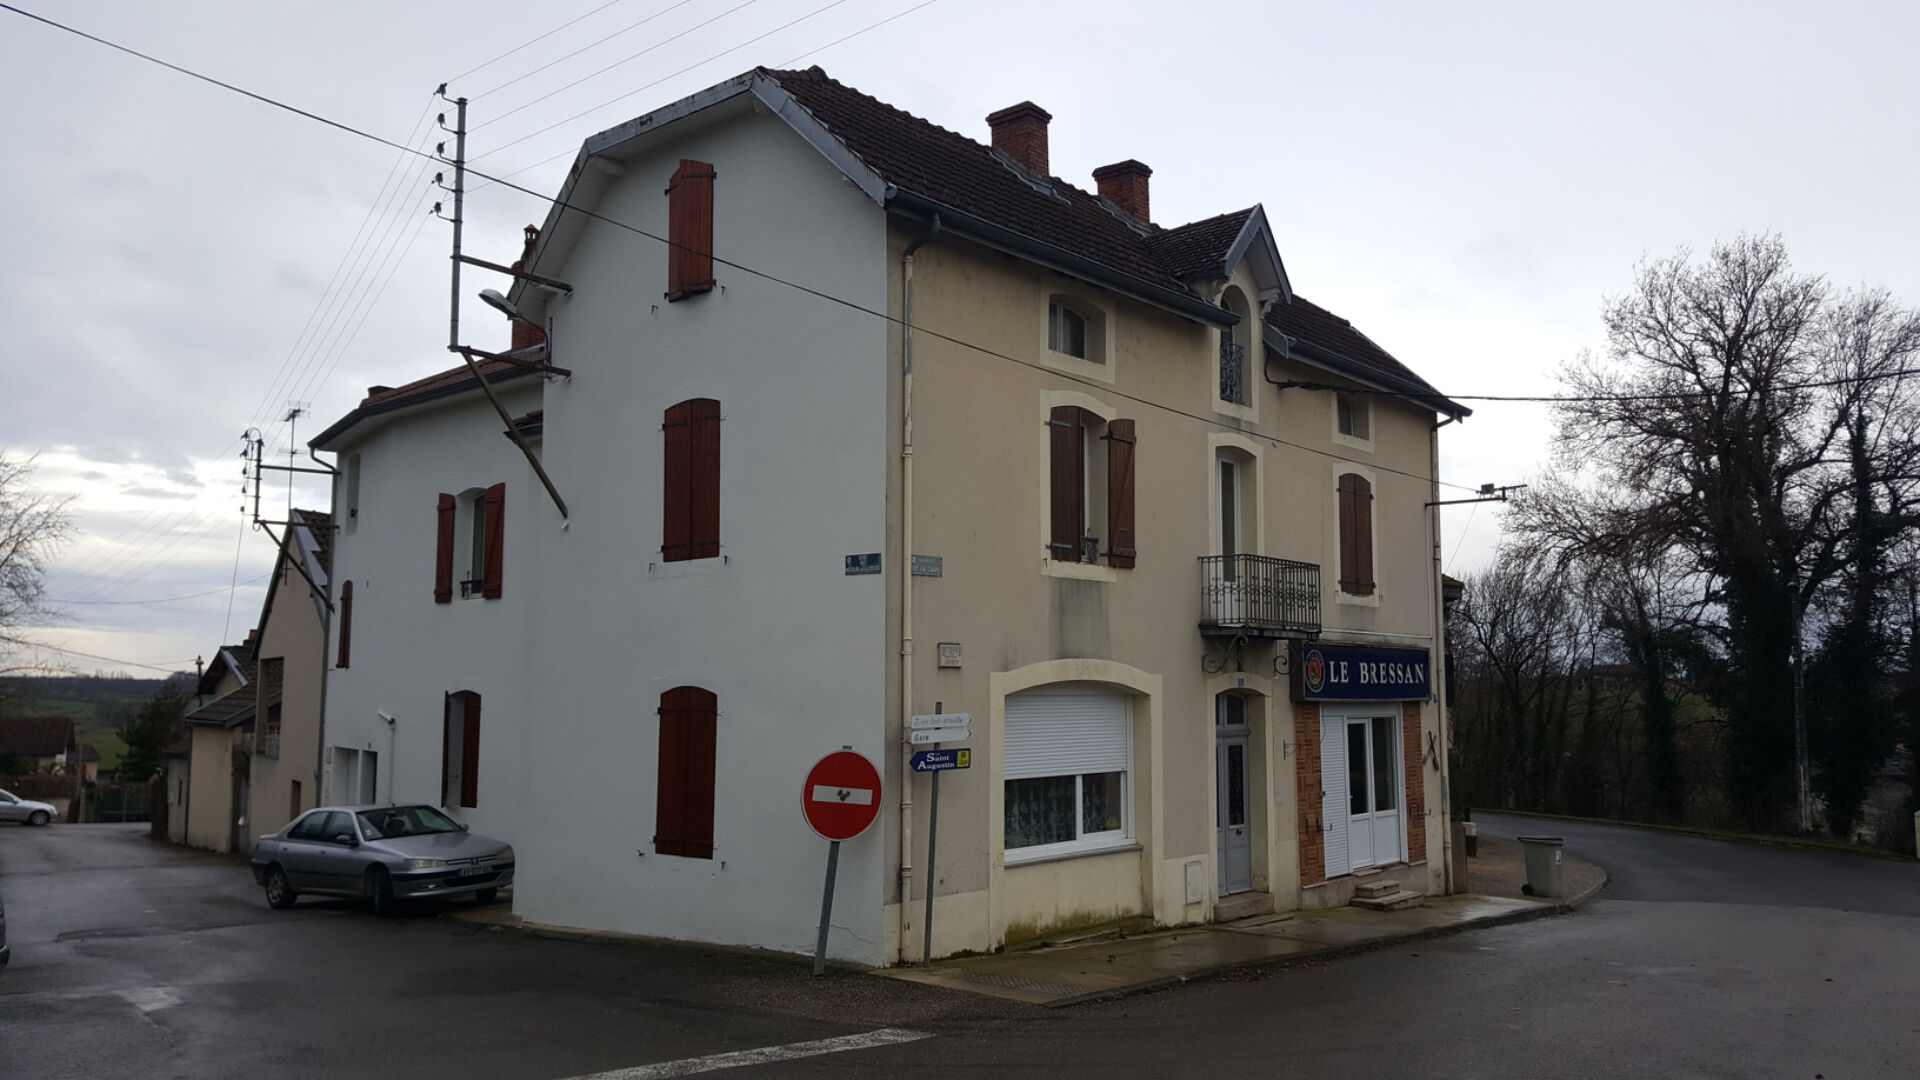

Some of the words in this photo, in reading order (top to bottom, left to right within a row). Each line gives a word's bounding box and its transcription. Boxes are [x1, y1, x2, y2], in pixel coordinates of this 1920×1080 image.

[1329, 661, 1349, 683] LE
[1360, 662, 1425, 684] BRESSAN
[926, 752, 950, 762] Saint
[917, 760, 955, 770] Augustin
